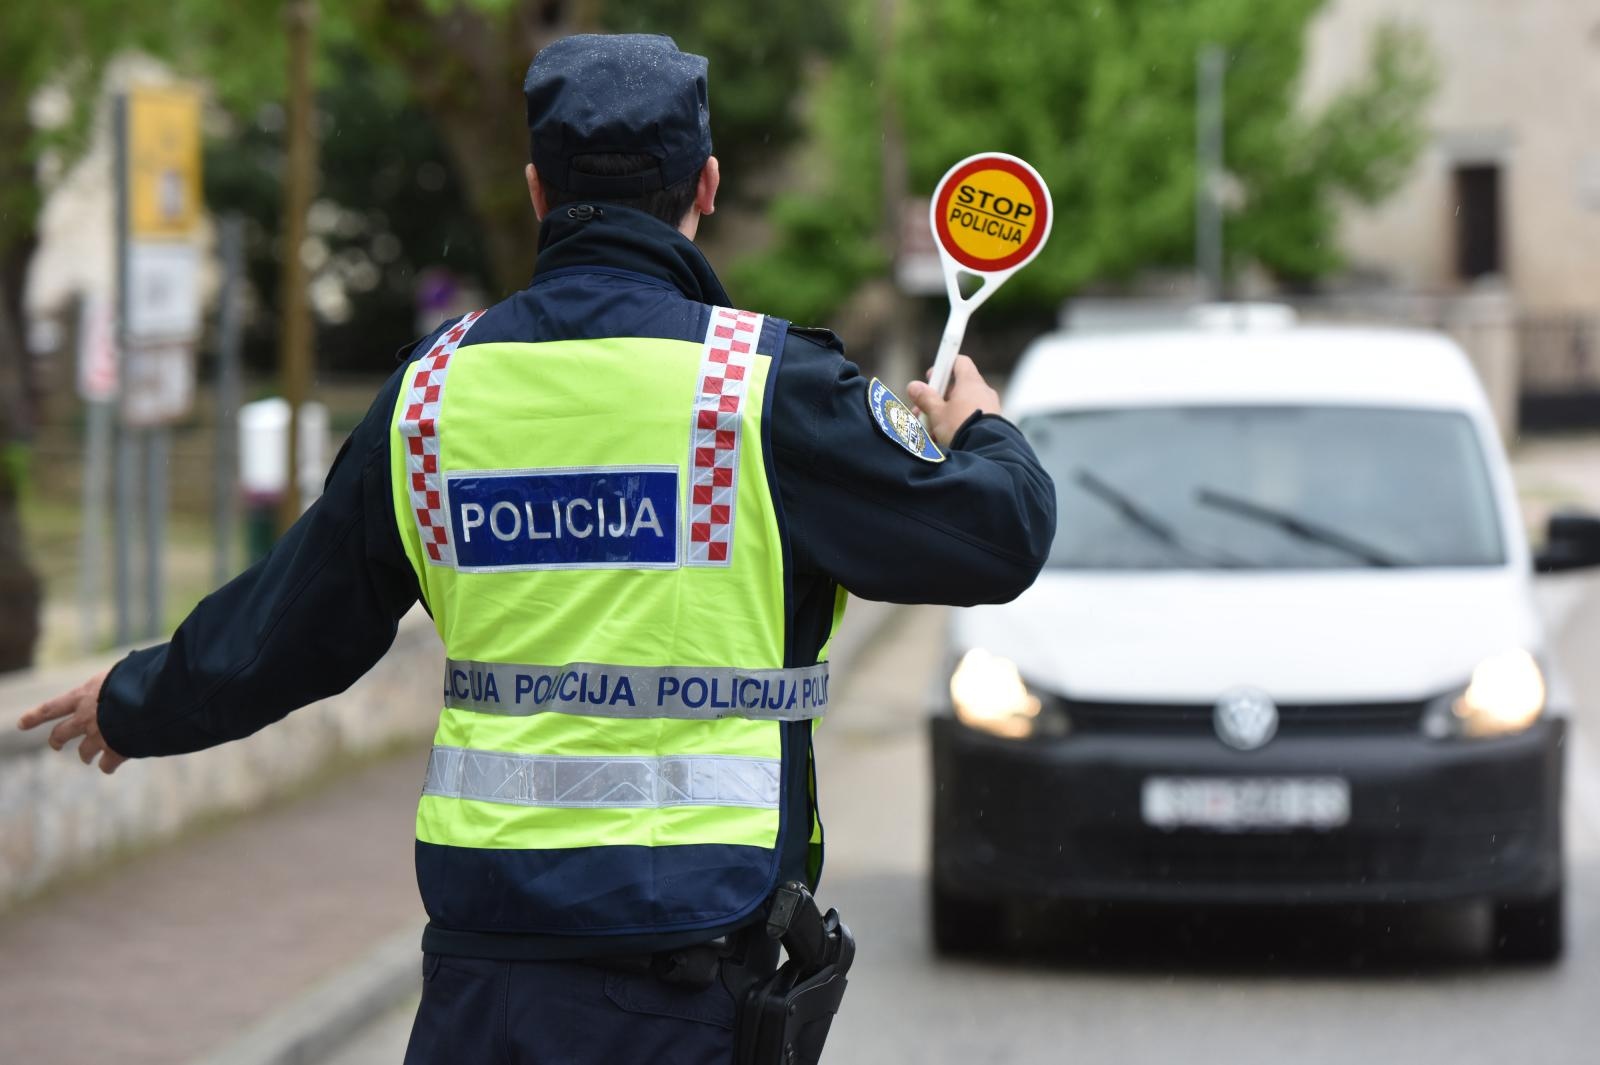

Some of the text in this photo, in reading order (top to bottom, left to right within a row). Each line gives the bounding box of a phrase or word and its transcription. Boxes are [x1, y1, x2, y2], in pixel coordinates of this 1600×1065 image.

[957, 185, 1033, 220] STOP
[949, 208, 1023, 245] POLICIJA
[461, 497, 663, 543] POLICIJA
[657, 677, 798, 710] POLICIJA
